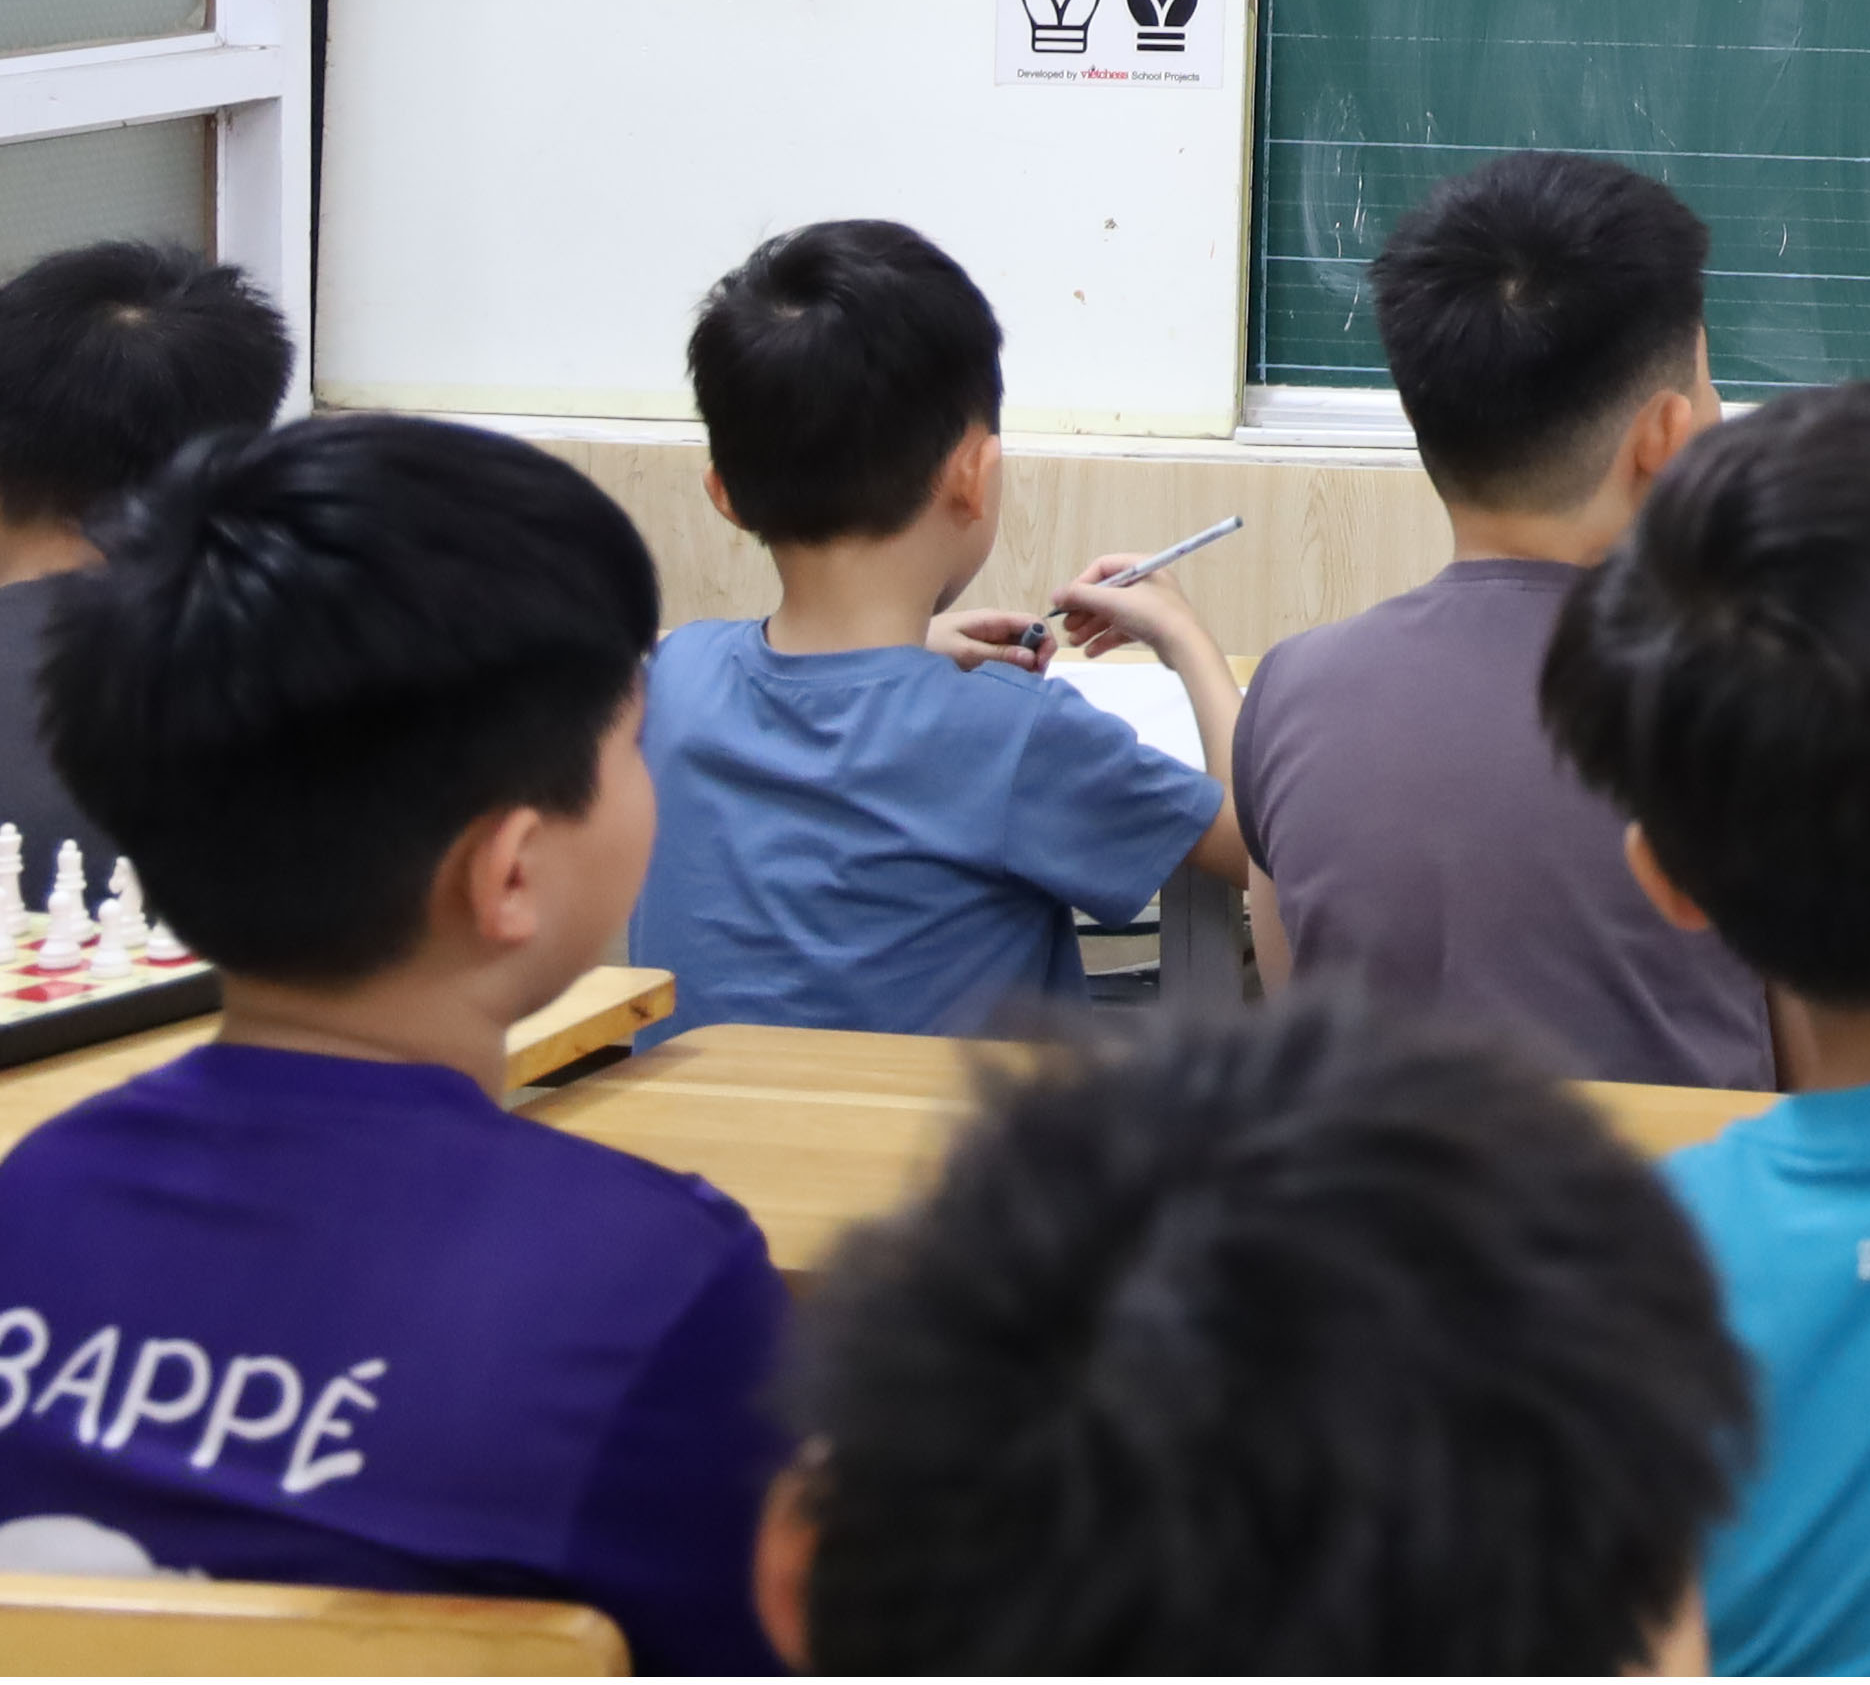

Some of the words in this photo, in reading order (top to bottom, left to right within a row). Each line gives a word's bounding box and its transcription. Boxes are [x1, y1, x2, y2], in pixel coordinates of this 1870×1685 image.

[1016, 68, 1065, 80] Developed
[1066, 69, 1078, 81] by
[1131, 71, 1162, 82] School
[1163, 72, 1201, 84] Projects
